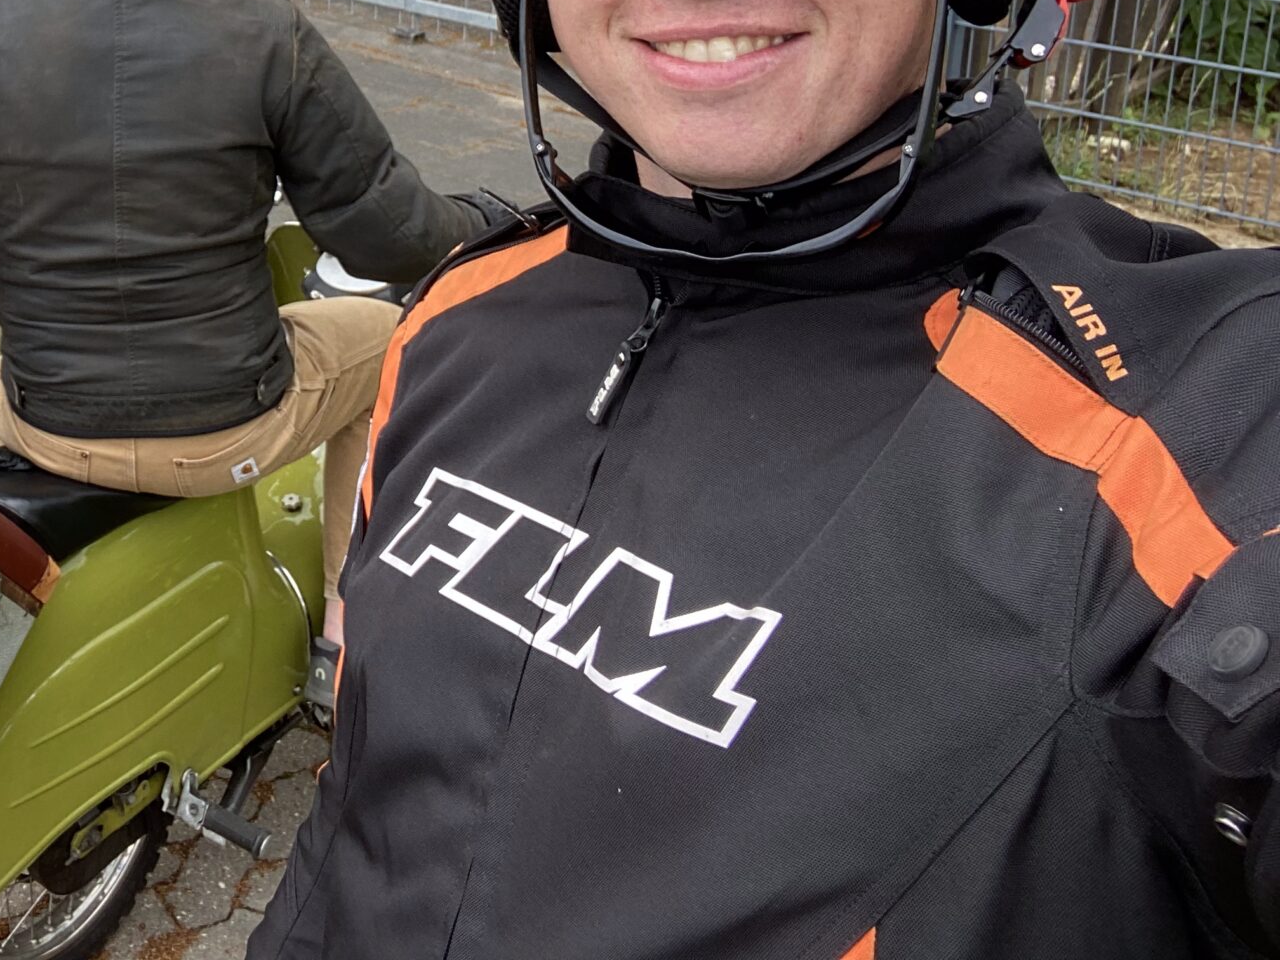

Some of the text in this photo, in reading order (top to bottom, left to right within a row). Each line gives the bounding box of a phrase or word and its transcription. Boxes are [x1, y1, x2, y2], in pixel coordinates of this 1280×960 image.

[1051, 284, 1131, 382] AIR IN
[379, 467, 783, 749] FLM
